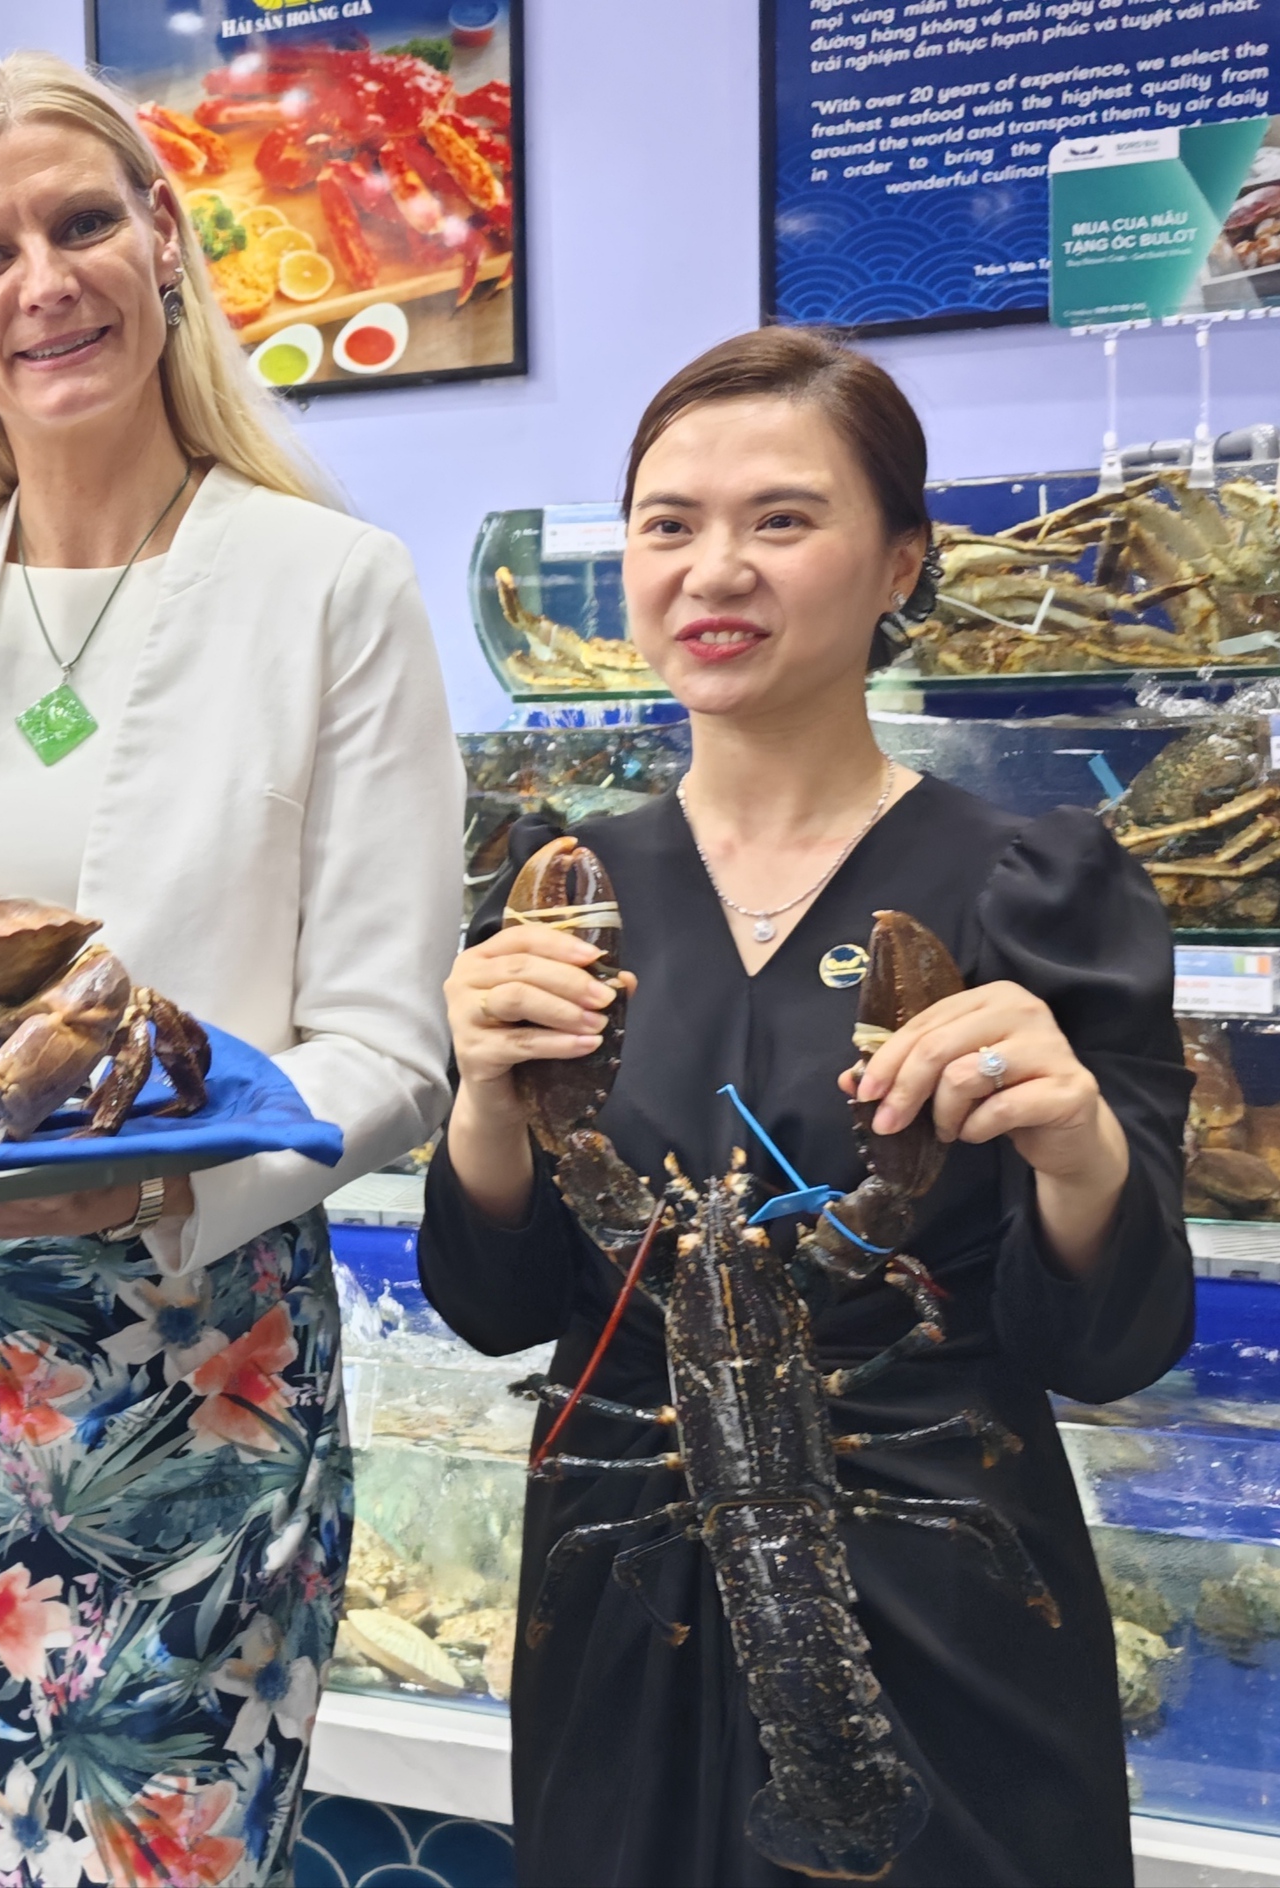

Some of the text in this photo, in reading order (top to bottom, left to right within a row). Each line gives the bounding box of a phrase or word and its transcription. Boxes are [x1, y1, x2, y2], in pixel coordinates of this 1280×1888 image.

[286, 5, 339, 28] HOÀNG
[342, 0, 373, 18] GIA
[810, 12, 843, 32] mọi
[851, 8, 896, 25] vùng
[810, 35, 867, 52] đường
[871, 26, 918, 43] hàng
[920, 18, 977, 36] không
[1045, 0, 1094, 20] ngày
[811, 55, 842, 73] trải
[844, 48, 911, 71] nghiệm
[991, 26, 1039, 50] hạnh
[1042, 20, 1091, 44] phúc
[865, 93, 906, 110] over
[908, 85, 934, 104] 20
[937, 81, 991, 104] years
[994, 73, 1018, 92] of
[1020, 62, 1131, 90] experience,
[1136, 57, 1165, 72] we
[1170, 46, 1230, 68] select
[1235, 41, 1269, 57] the
[810, 137, 876, 160] around
[879, 136, 909, 152] the
[912, 126, 965, 147] world
[967, 120, 1006, 141] and
[1008, 110, 1097, 136] transport
[1101, 104, 1151, 123] them
[1155, 100, 1182, 119] by
[1185, 95, 1214, 112] air
[1217, 87, 1269, 108] daily
[811, 66, 1269, 138] freshest seafood with the highest quality from
[810, 141, 1043, 182] in order to bring the
[885, 164, 1051, 194] wonderful culinar
[1071, 220, 1111, 237] MUA
[1112, 215, 1149, 232] CUA
